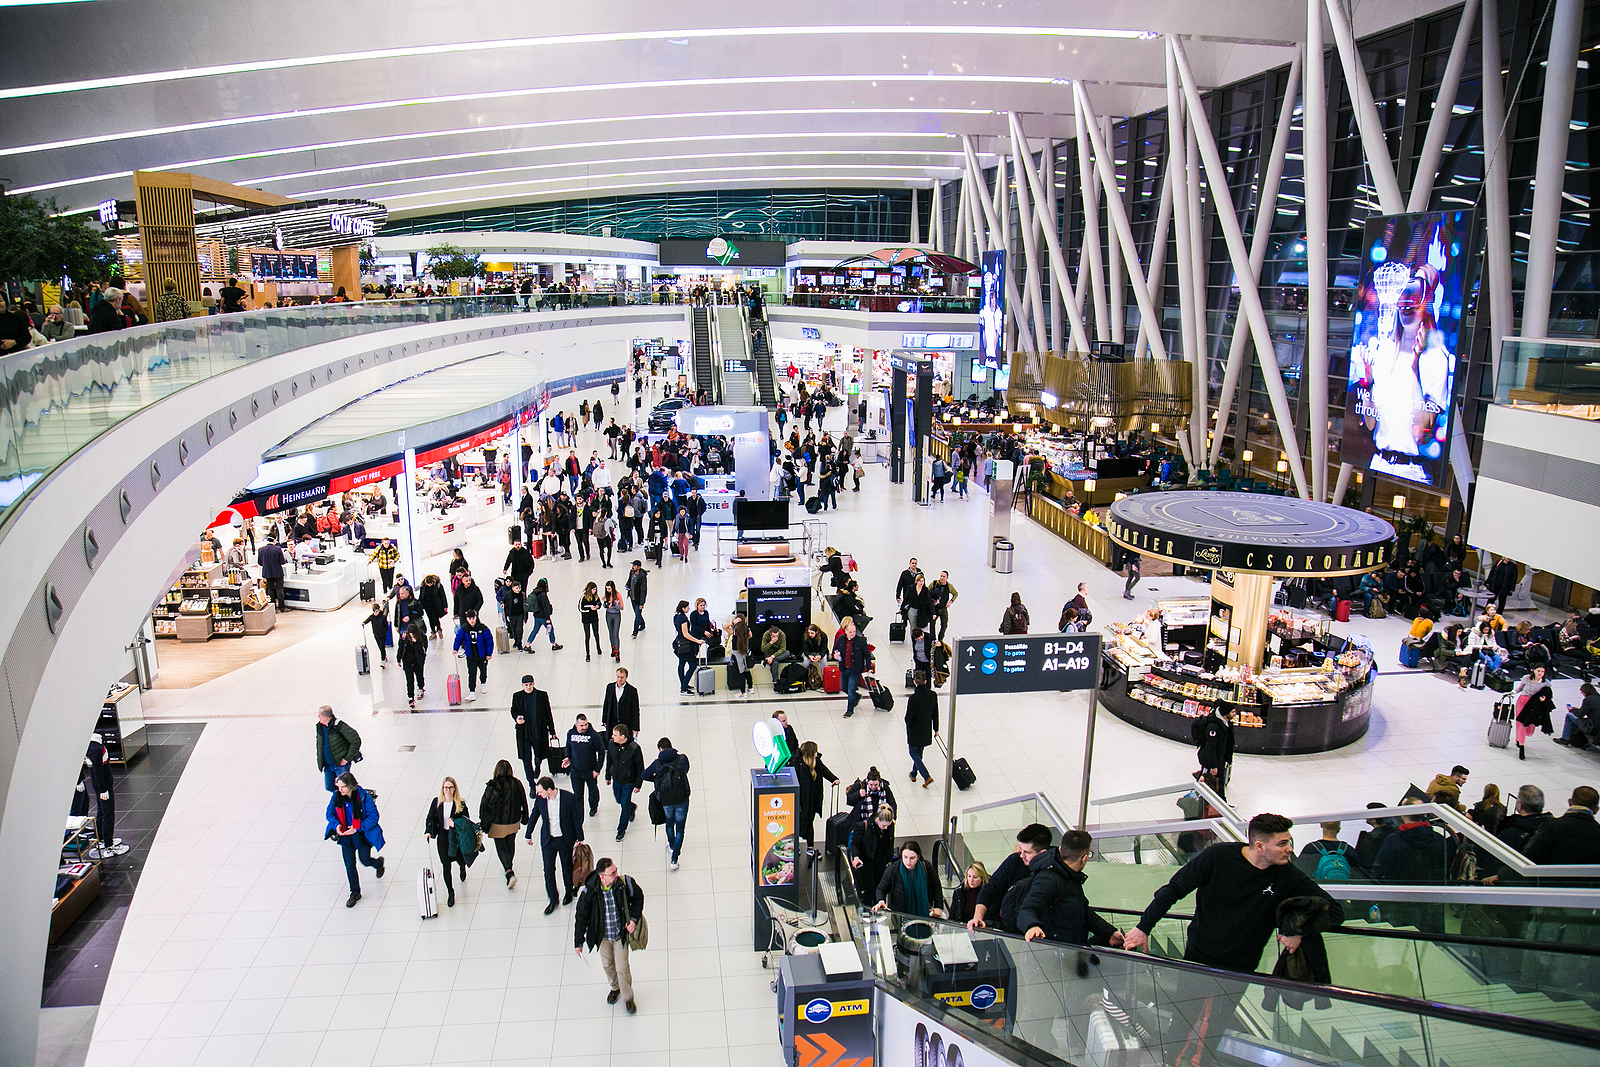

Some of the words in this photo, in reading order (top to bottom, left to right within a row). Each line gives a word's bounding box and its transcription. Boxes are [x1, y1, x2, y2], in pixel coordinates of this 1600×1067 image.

[1356, 387, 1370, 401] We
[1354, 401, 1382, 422] throug
[353, 475, 368, 484] DUTY
[368, 471, 381, 480] FREE
[282, 485, 326, 504] HEINEMANN
[1246, 546, 1385, 570] CSOKOLÁDÉ
[839, 1004, 863, 1012] ATM
